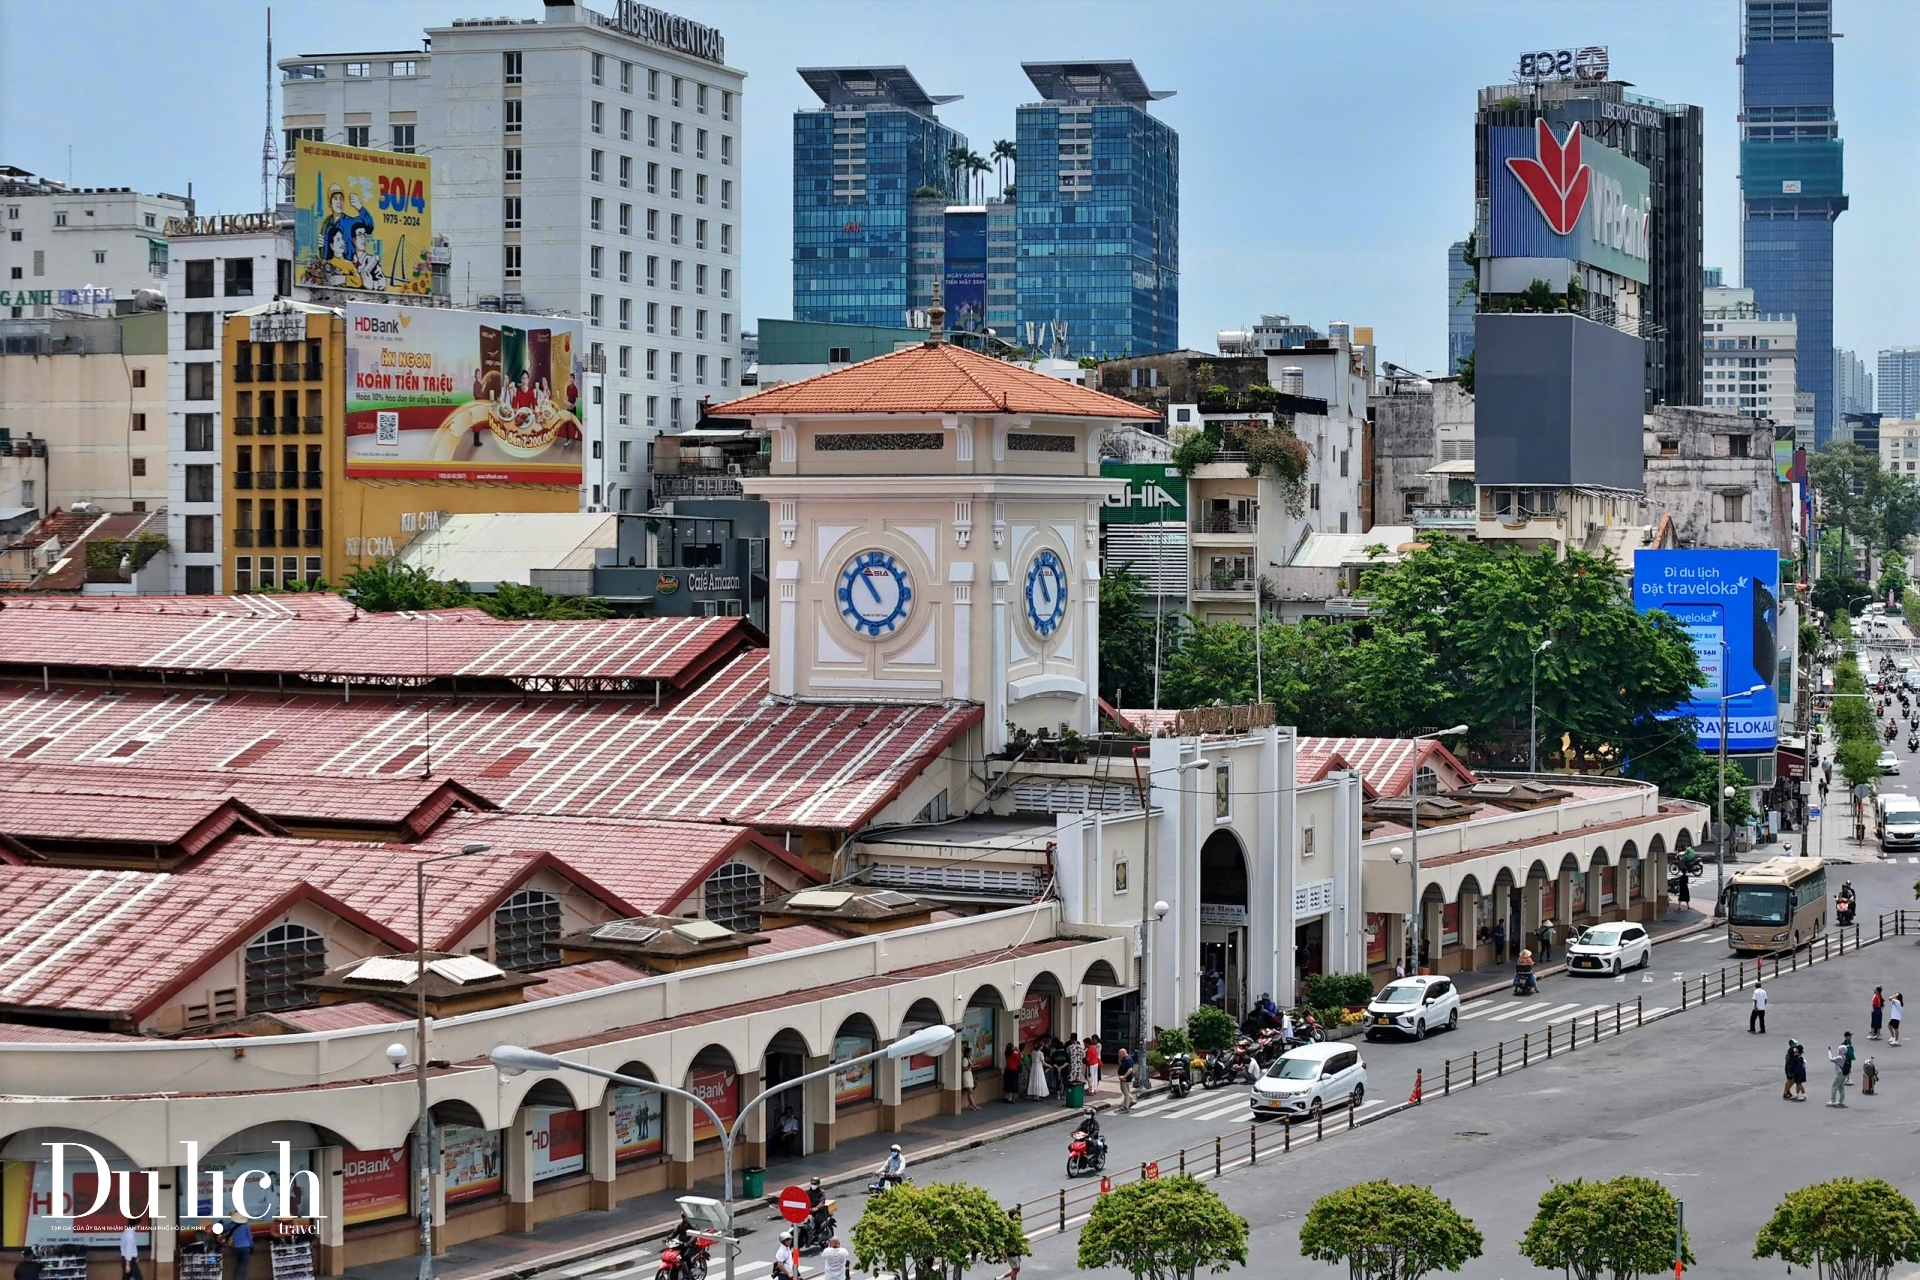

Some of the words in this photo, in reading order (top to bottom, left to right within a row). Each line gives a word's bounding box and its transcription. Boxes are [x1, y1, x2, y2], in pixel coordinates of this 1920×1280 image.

[620, 0, 669, 44] LIBERTY
[670, 14, 723, 62] CENTRAL
[1601, 101, 1630, 122] LIBERTY
[1630, 107, 1661, 129] CENTRAL
[378, 175, 426, 214] 30/4
[383, 213, 398, 224] 1975
[403, 215, 420, 227] 2024
[1590, 168, 1652, 262] VPBank
[219, 212, 283, 236] HOTEL
[15, 290, 52, 305] ANH
[58, 288, 114, 305] HOTEL
[355, 317, 399, 334] HDBank
[399, 351, 431, 369] NGON
[395, 369, 419, 391] TIỀN
[423, 373, 453, 396] TRIỆU
[1100, 479, 1181, 507] GHĨA
[418, 511, 440, 531] CHA
[367, 536, 395, 557] CHA
[868, 552, 883, 565] 12
[688, 570, 708, 591] Café
[708, 573, 740, 591] Amazon
[863, 568, 889, 576] ASIA
[1664, 567, 1677, 578] Đi
[1680, 567, 1695, 578] du
[1698, 567, 1720, 580] lịch
[838, 588, 848, 601] 9
[901, 587, 911, 601] 3
[1642, 583, 1664, 597] Đặt
[1667, 581, 1738, 595] traveloka
[1677, 611, 1712, 622] veloka
[868, 624, 879, 636] 6
[1703, 649, 1716, 657] SẠN
[1696, 720, 1777, 733] RAVELOKALA
[1019, 1005, 1039, 1020] Bank
[692, 1081, 724, 1101] DBank
[198, 1163, 228, 1173] DBank
